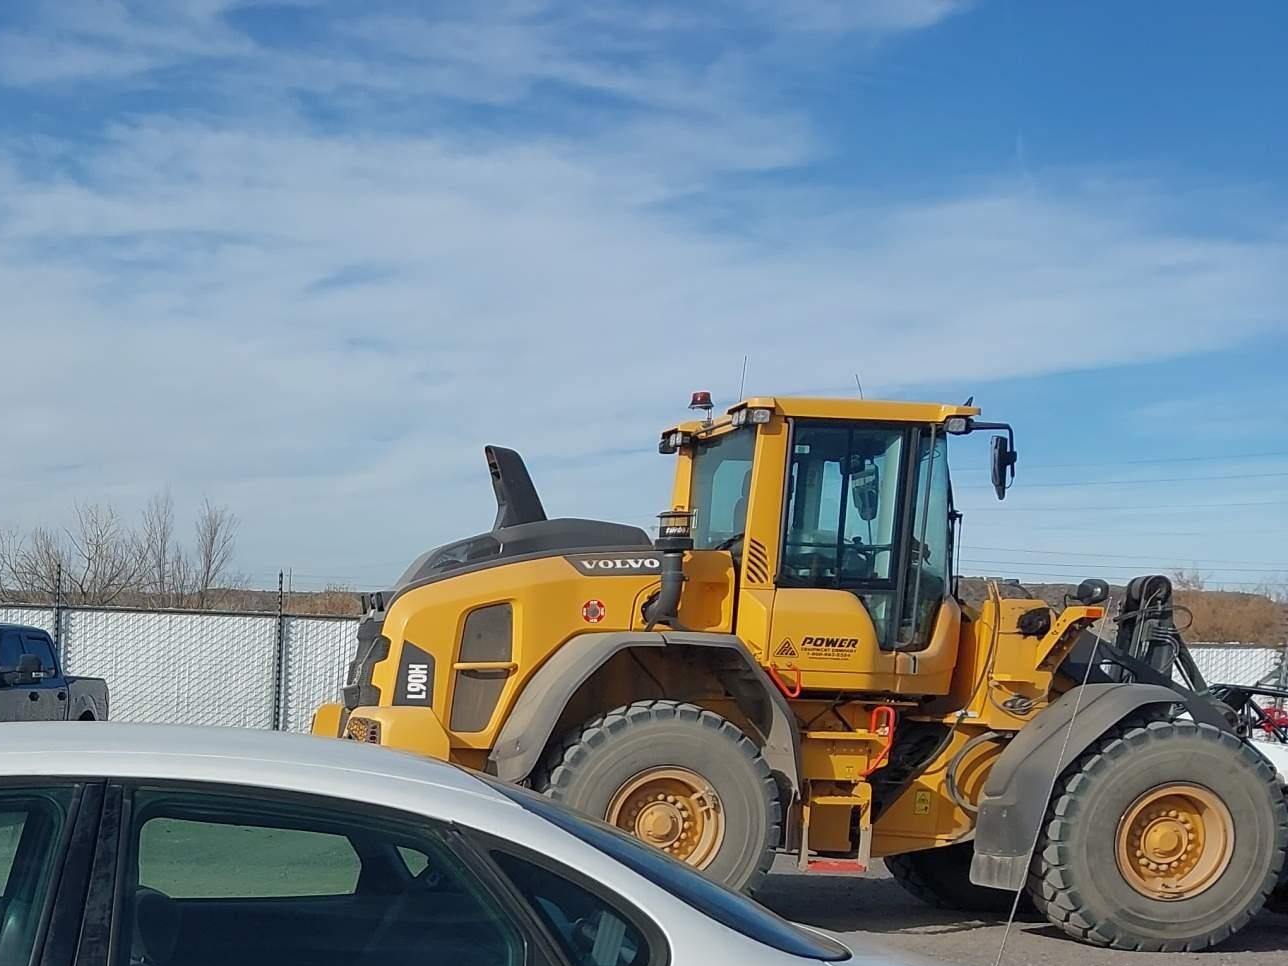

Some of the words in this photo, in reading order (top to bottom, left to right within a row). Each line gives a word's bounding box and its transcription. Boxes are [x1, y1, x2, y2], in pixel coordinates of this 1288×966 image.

[582, 558, 660, 569] VOLVO
[801, 636, 859, 649] POWER
[406, 663, 428, 699] L90H
